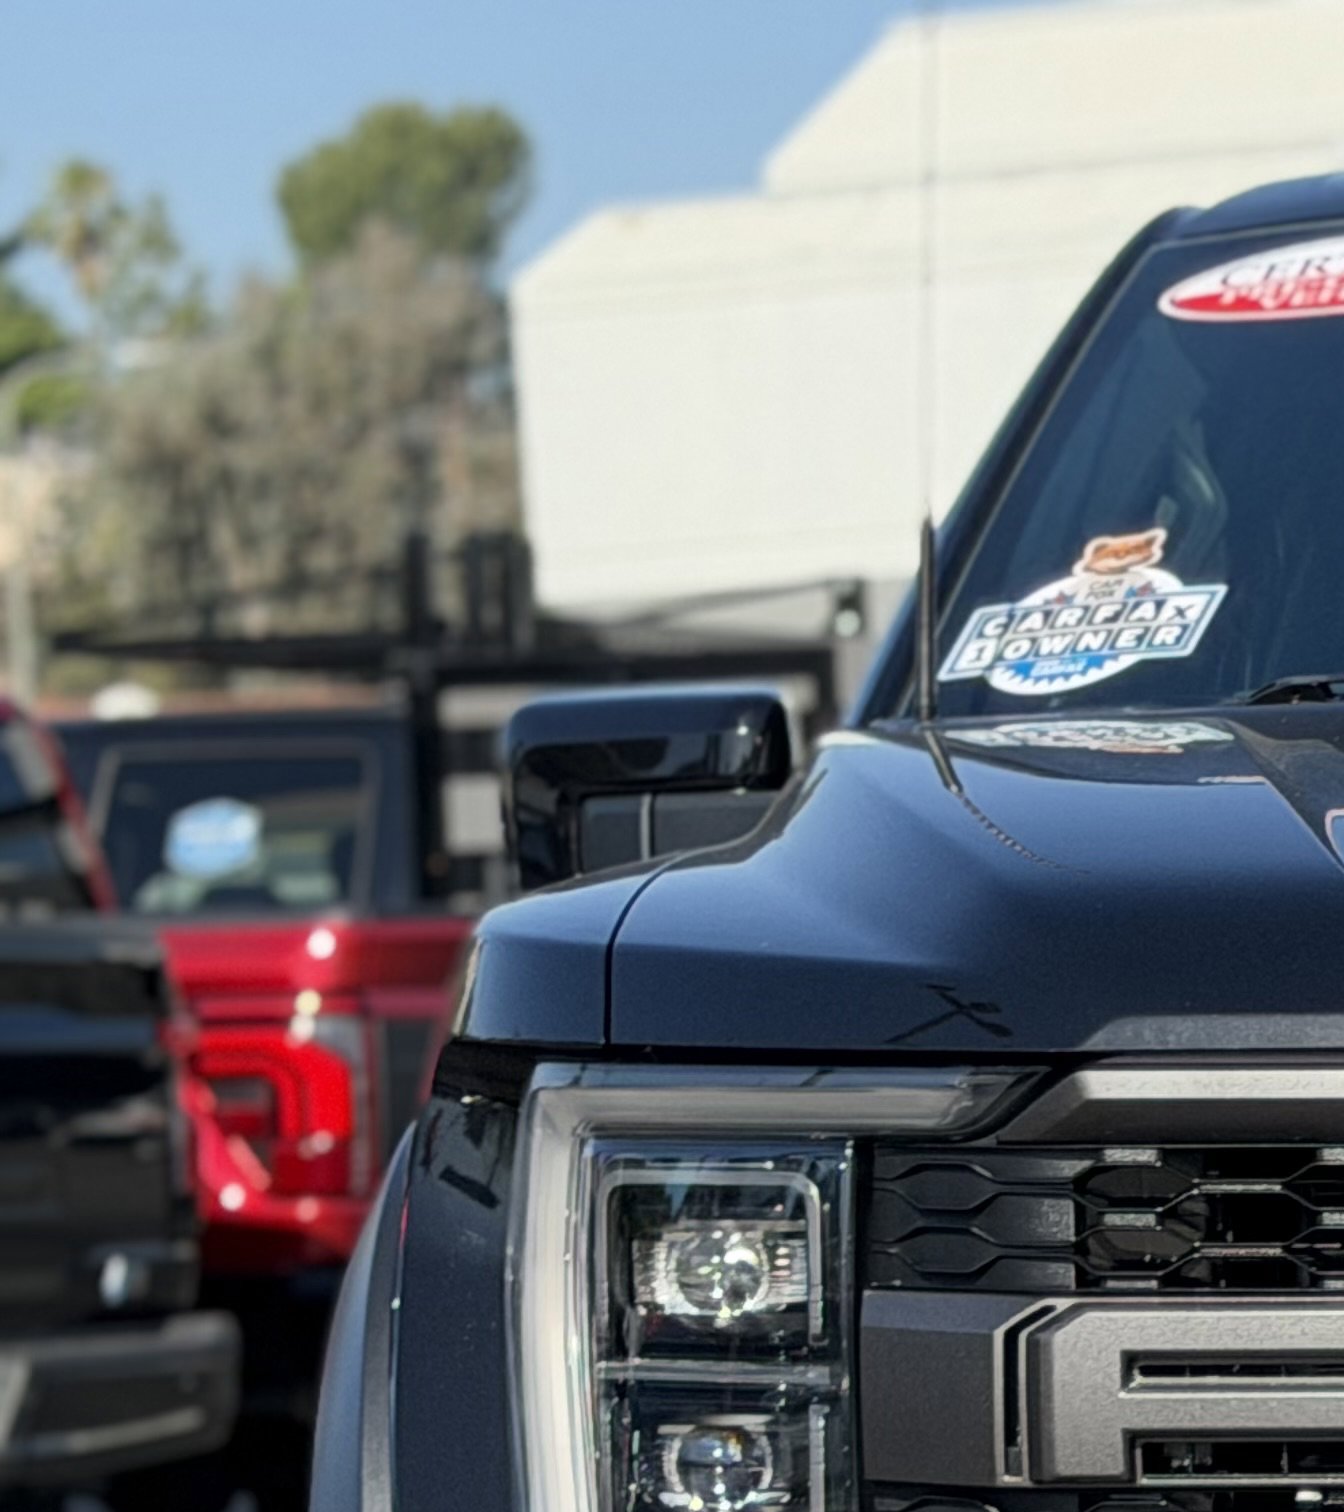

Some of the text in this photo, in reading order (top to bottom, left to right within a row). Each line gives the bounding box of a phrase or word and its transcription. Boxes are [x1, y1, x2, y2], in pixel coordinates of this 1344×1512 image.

[982, 600, 1196, 638] CARFAX
[966, 624, 1180, 664] 1 OWNER
